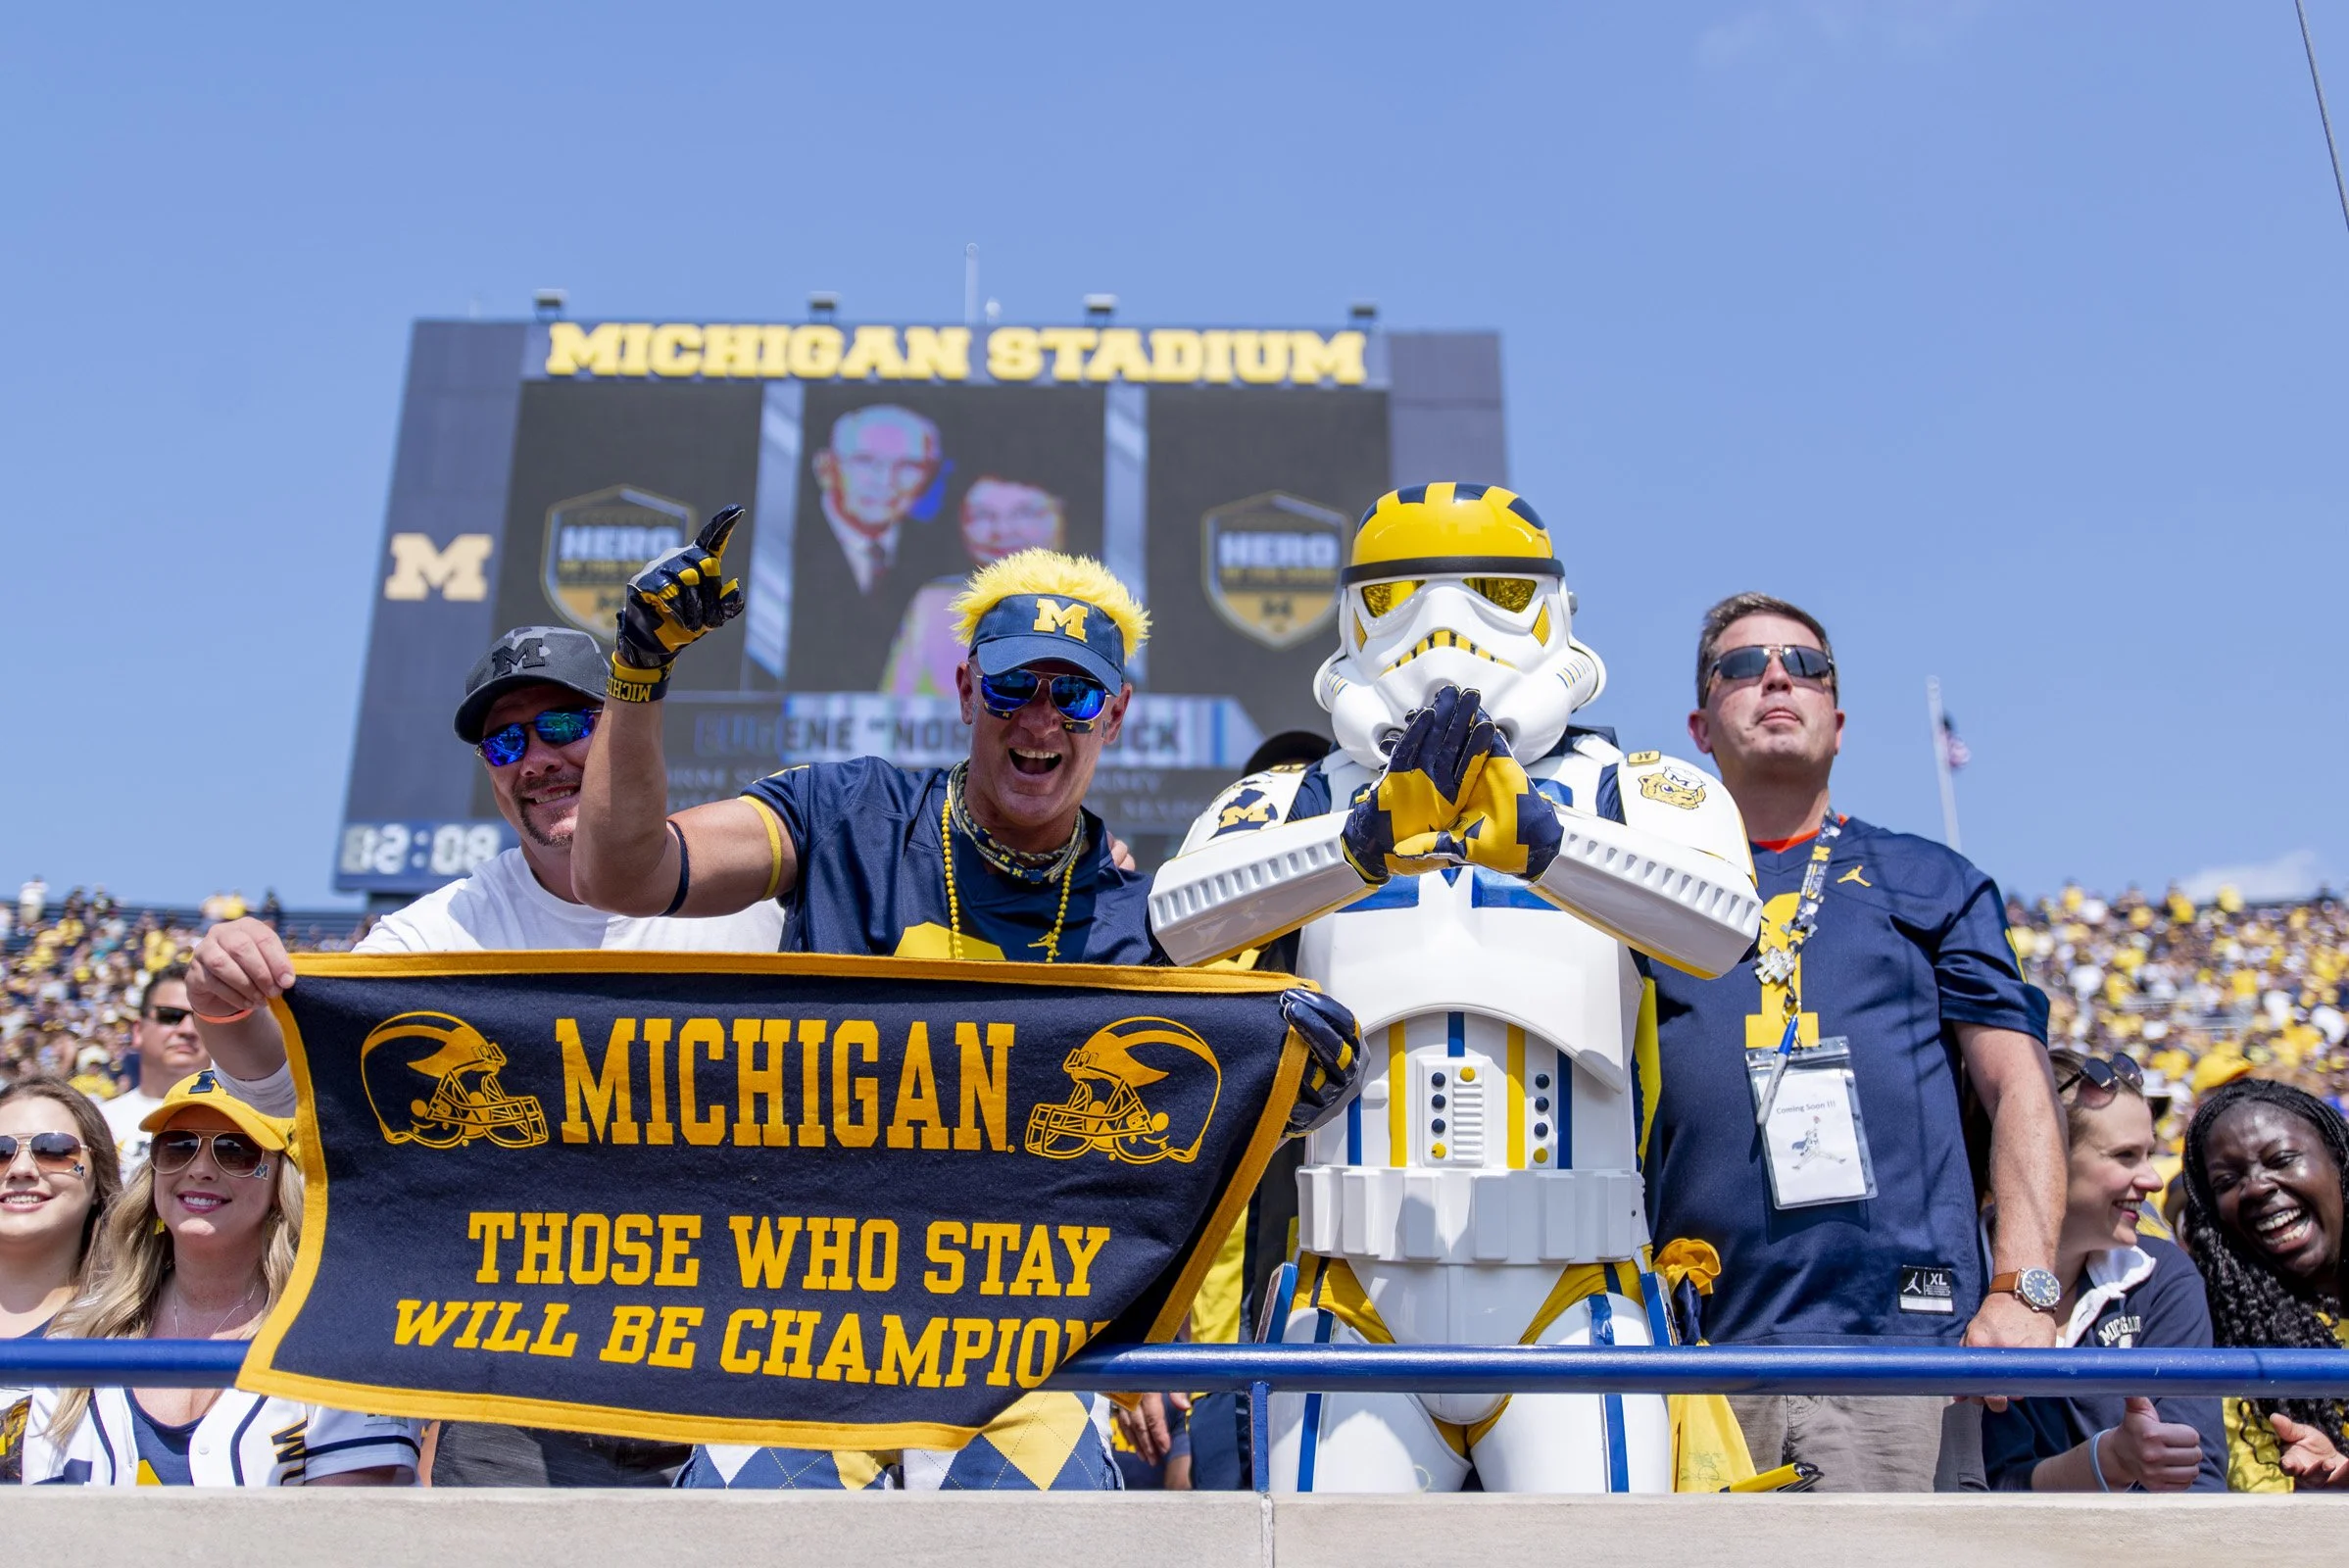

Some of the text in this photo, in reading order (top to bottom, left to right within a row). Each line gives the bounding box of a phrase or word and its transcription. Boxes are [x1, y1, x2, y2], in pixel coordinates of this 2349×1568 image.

[546, 323, 1367, 384] MICHIGAN STADIUM
[383, 533, 494, 602] M
[1034, 599, 1088, 641] M
[492, 637, 545, 677] M
[1219, 805, 1269, 829] M
[556, 1017, 1015, 1152] MICHIGAN
[1776, 1104, 1805, 1115] Coming
[1806, 1102, 1826, 1110] Soon
[467, 1211, 1110, 1297] THOSE WHO STAY
[1930, 1273, 1947, 1286] XL
[394, 1299, 578, 1358] WILL
[600, 1304, 705, 1370] BE
